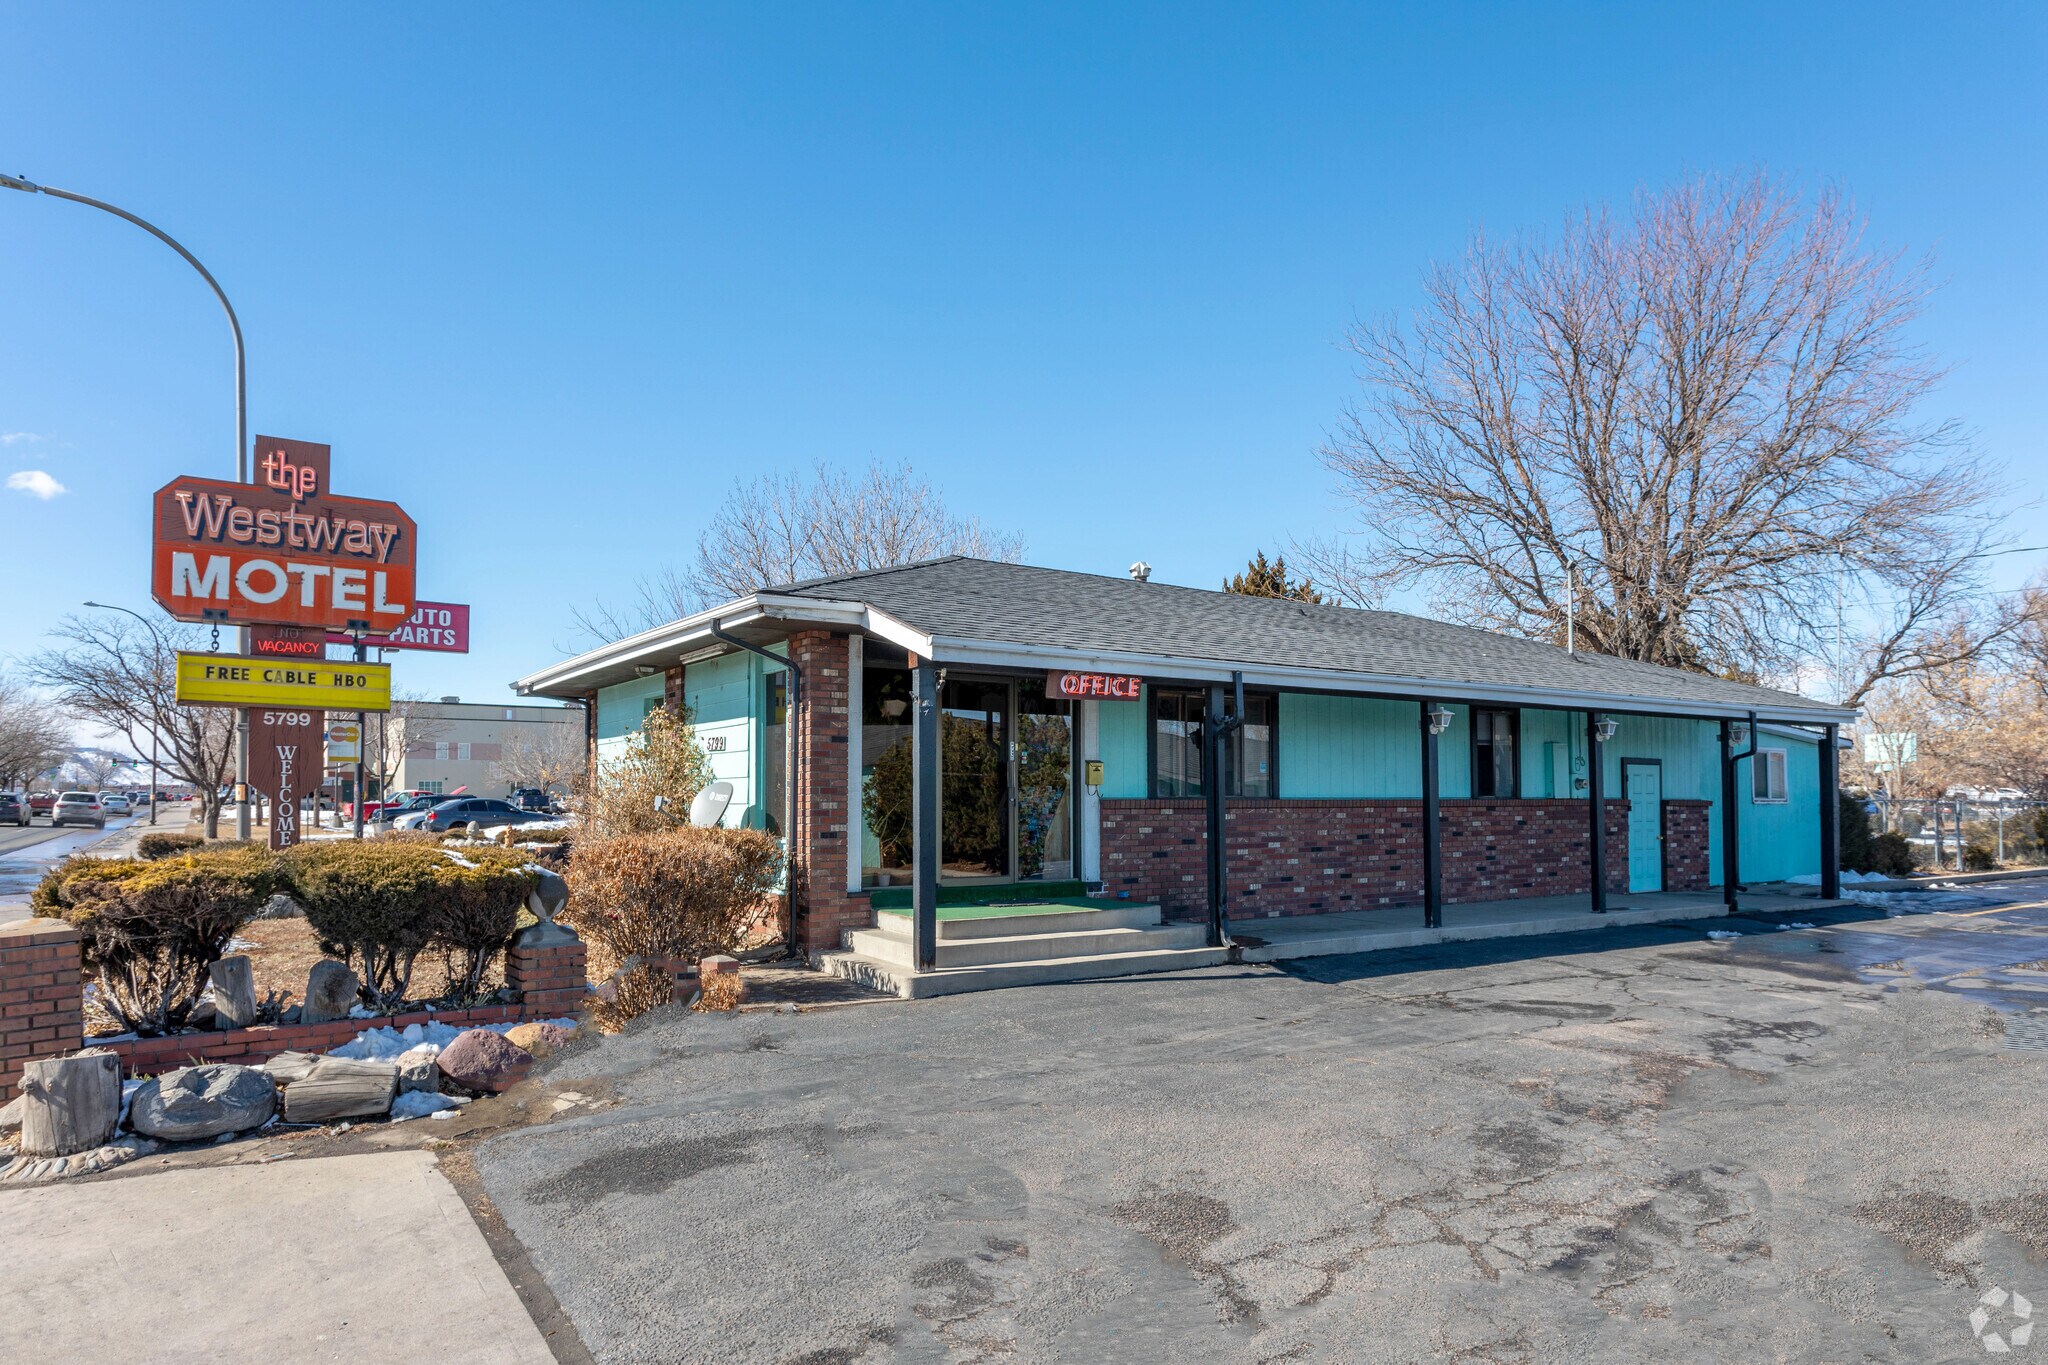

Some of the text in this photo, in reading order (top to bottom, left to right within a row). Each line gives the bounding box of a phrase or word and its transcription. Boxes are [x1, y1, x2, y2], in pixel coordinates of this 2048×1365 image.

[262, 450, 317, 500] the
[175, 490, 397, 564] Westway
[172, 551, 405, 614] MOTEL
[406, 608, 451, 627] UTO
[257, 639, 320, 654] VACANCY
[205, 666, 367, 688] FREE CABLE HBO
[1060, 674, 1140, 697] OFFICE
[263, 711, 311, 726] 5799
[276, 745, 297, 846] WELCOME
